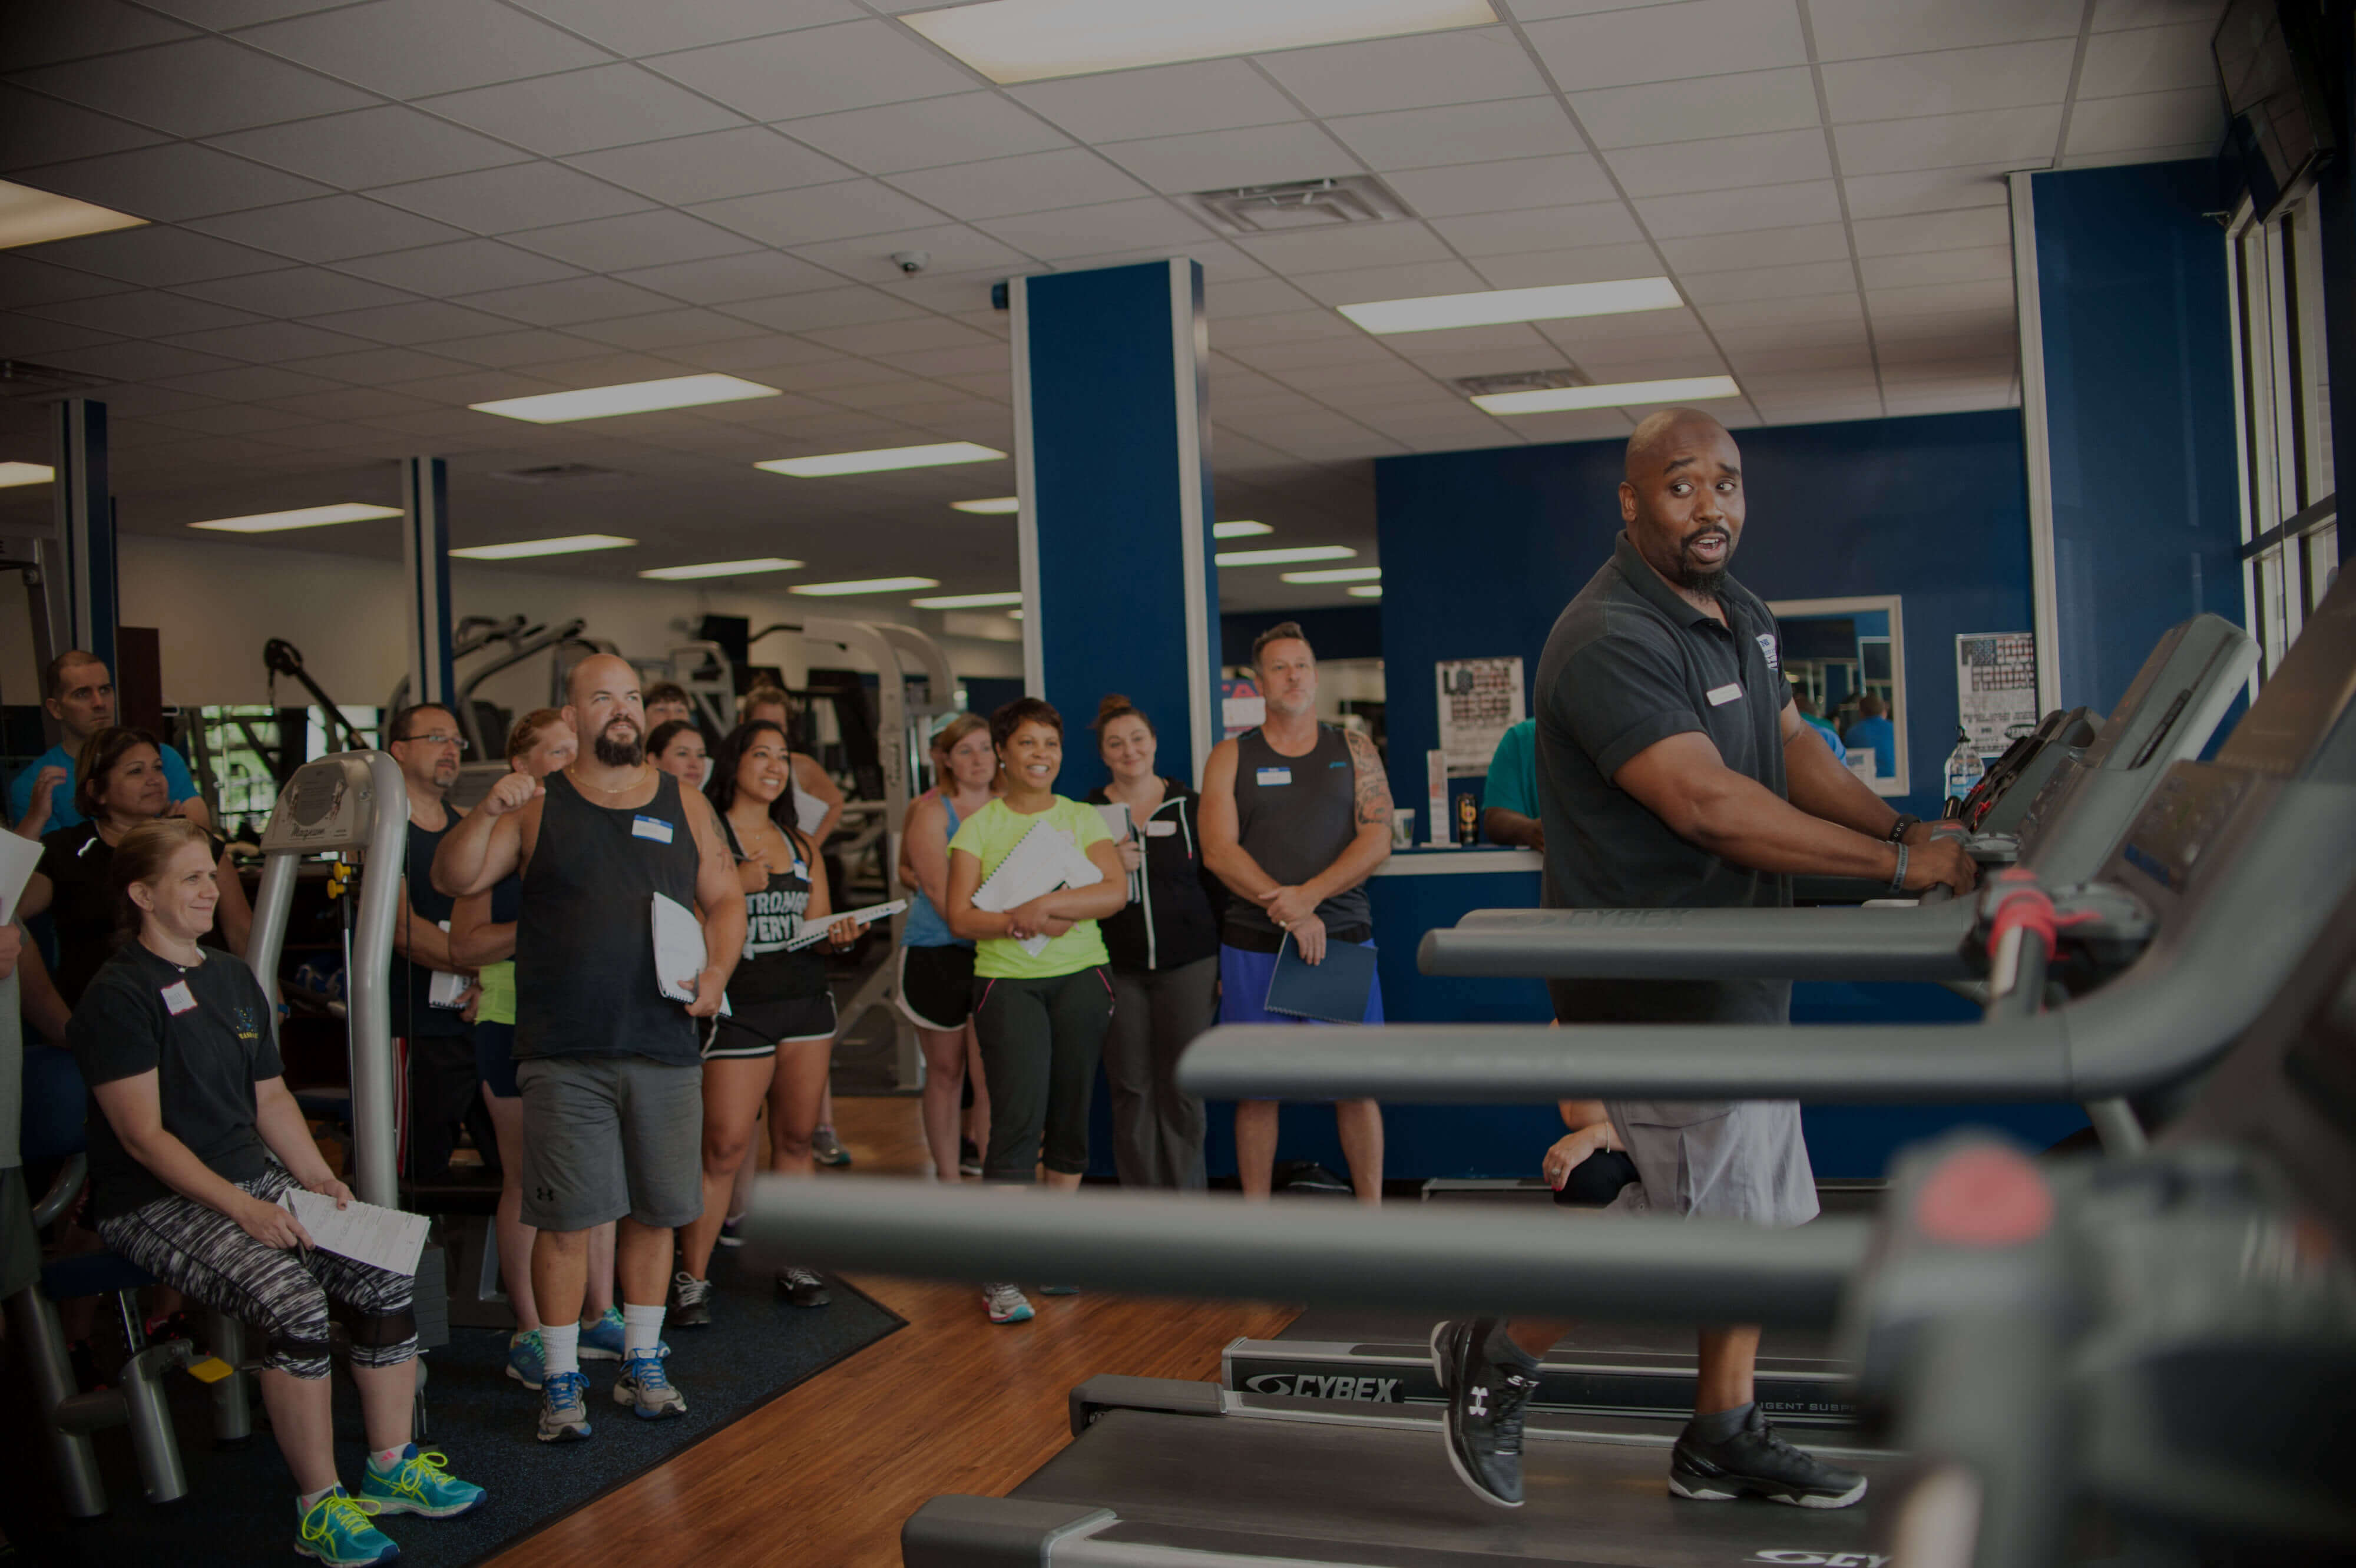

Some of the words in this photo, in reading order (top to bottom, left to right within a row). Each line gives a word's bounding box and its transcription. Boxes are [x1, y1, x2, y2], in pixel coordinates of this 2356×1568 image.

[745, 891, 810, 915] TRONG
[1293, 1374, 1400, 1403] CYBEX
[1760, 1401, 1805, 1410] IGENT
